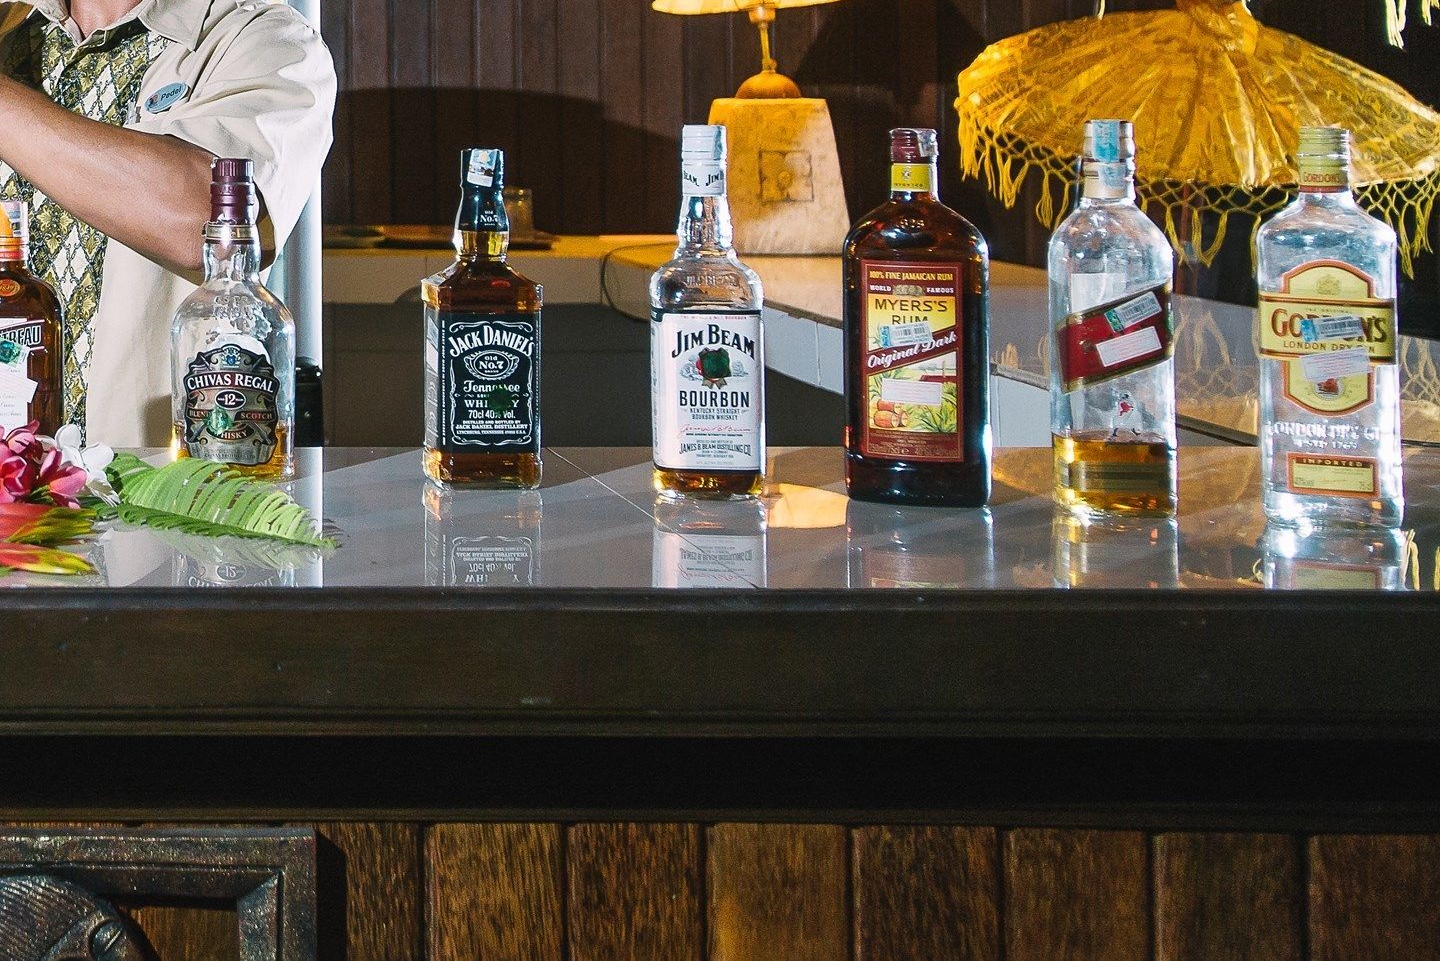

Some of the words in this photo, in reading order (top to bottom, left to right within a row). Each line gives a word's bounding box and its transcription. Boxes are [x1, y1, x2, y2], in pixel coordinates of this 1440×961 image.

[885, 271, 901, 280] FINE
[901, 271, 936, 281] JAMAICAN
[936, 273, 954, 281] RUM
[869, 284, 892, 292] WORLD
[875, 298, 948, 312] MYERS'S
[448, 330, 483, 357] JACK
[671, 329, 704, 358] JIM
[707, 323, 755, 360] BEAM
[1283, 340, 1327, 351] LONDON
[868, 344, 920, 368] Original
[922, 331, 957, 351] Dark
[479, 360, 504, 370] No.7
[187, 373, 232, 390] CHIVAS
[234, 373, 274, 393] REGAL
[224, 393, 236, 406] 12
[464, 399, 520, 408] WHIY
[679, 390, 750, 408] BOURBON
[468, 409, 484, 419] 70cl
[220, 429, 247, 439] HISKY
[1303, 458, 1363, 467] IMPORTED
